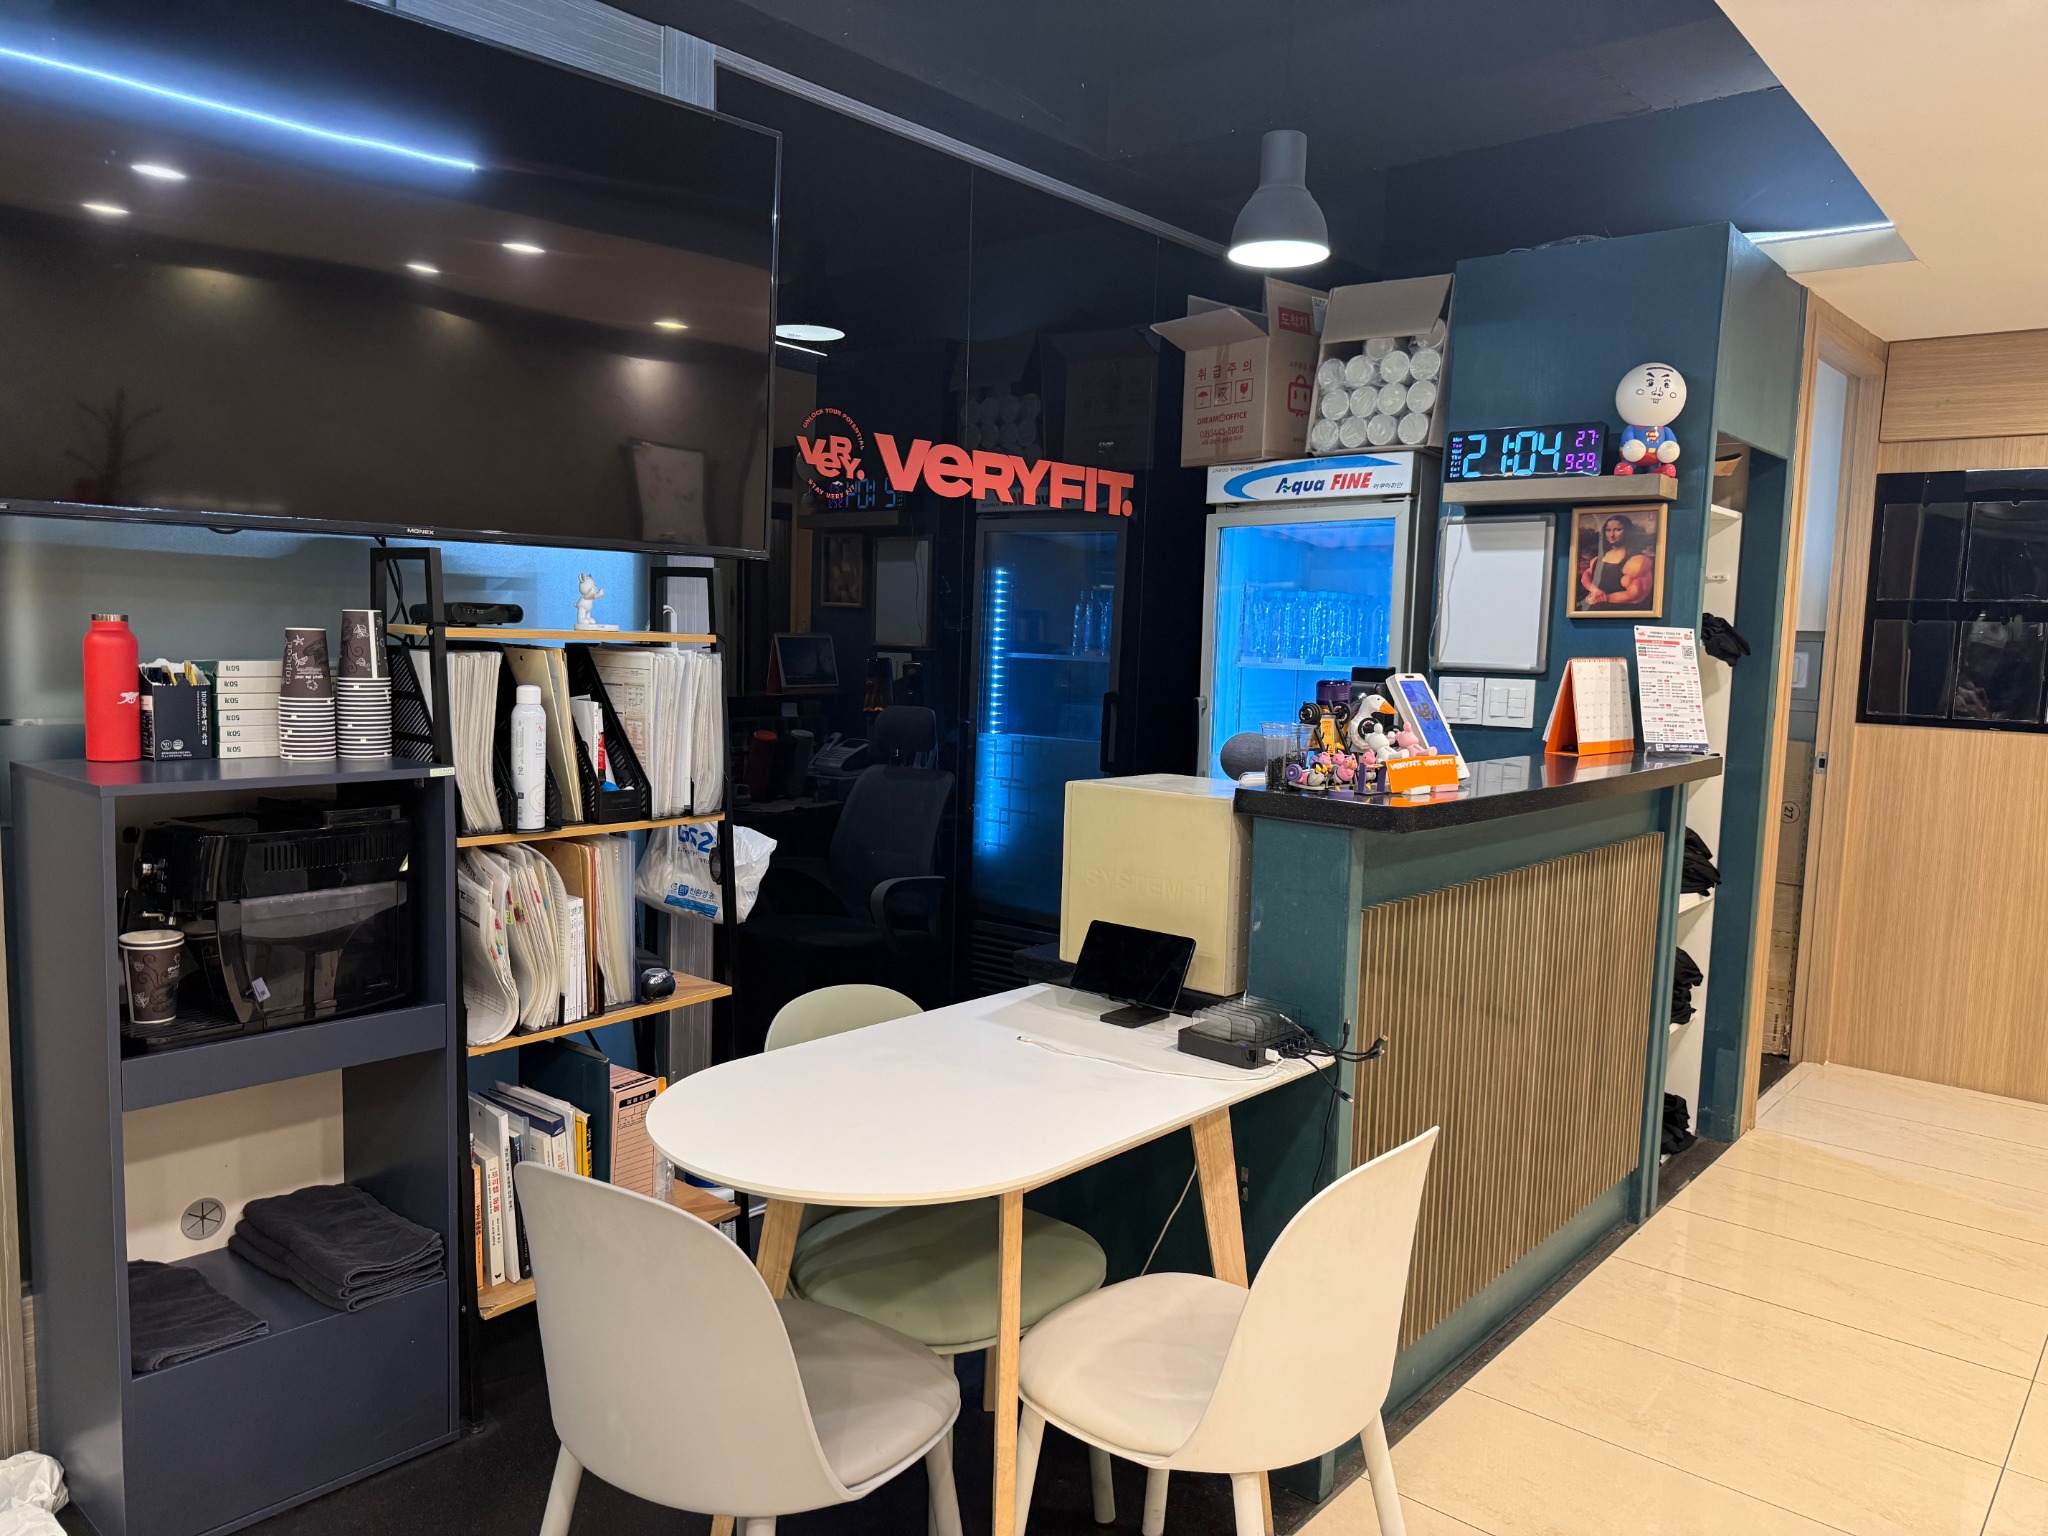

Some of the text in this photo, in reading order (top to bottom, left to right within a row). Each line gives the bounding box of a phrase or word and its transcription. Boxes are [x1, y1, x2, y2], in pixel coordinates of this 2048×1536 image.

[1197, 359, 1252, 381] 취급주의
[802, 407, 865, 451] UNLOCK YOUR POTENTIAL
[1462, 430, 1562, 478] 21:04
[808, 479, 824, 495] STAY
[845, 484, 855, 495] FIT
[1275, 472, 1373, 495] Aqua FINE
[407, 528, 435, 536] MONEX
[1783, 806, 1794, 820] 27
